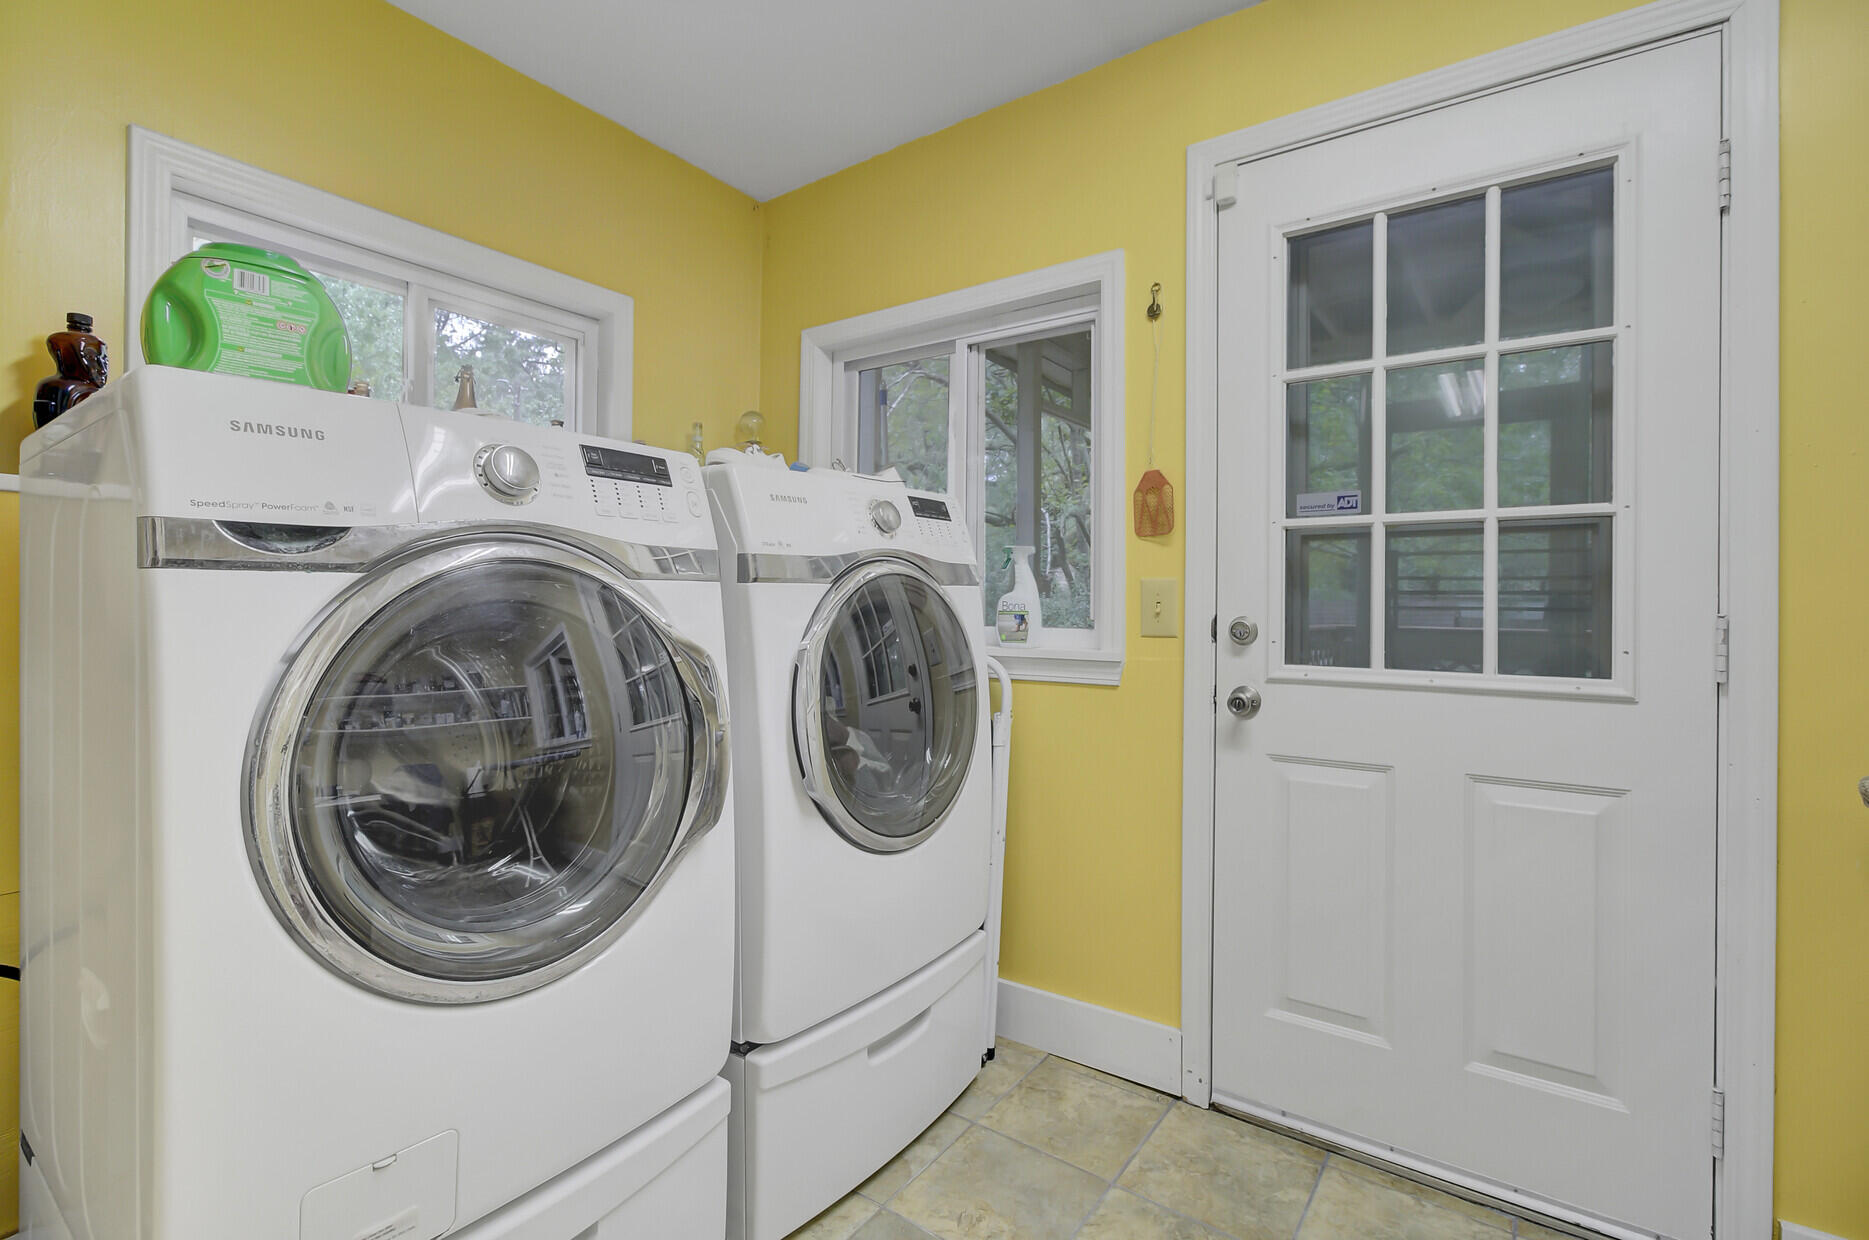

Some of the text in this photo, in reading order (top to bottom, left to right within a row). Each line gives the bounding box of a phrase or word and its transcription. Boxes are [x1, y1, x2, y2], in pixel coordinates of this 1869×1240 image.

[230, 419, 325, 440] SAMSUNG
[769, 493, 808, 505] SAMSUNG
[1337, 496, 1358, 509] ADT
[1001, 600, 1026, 611] Bona
